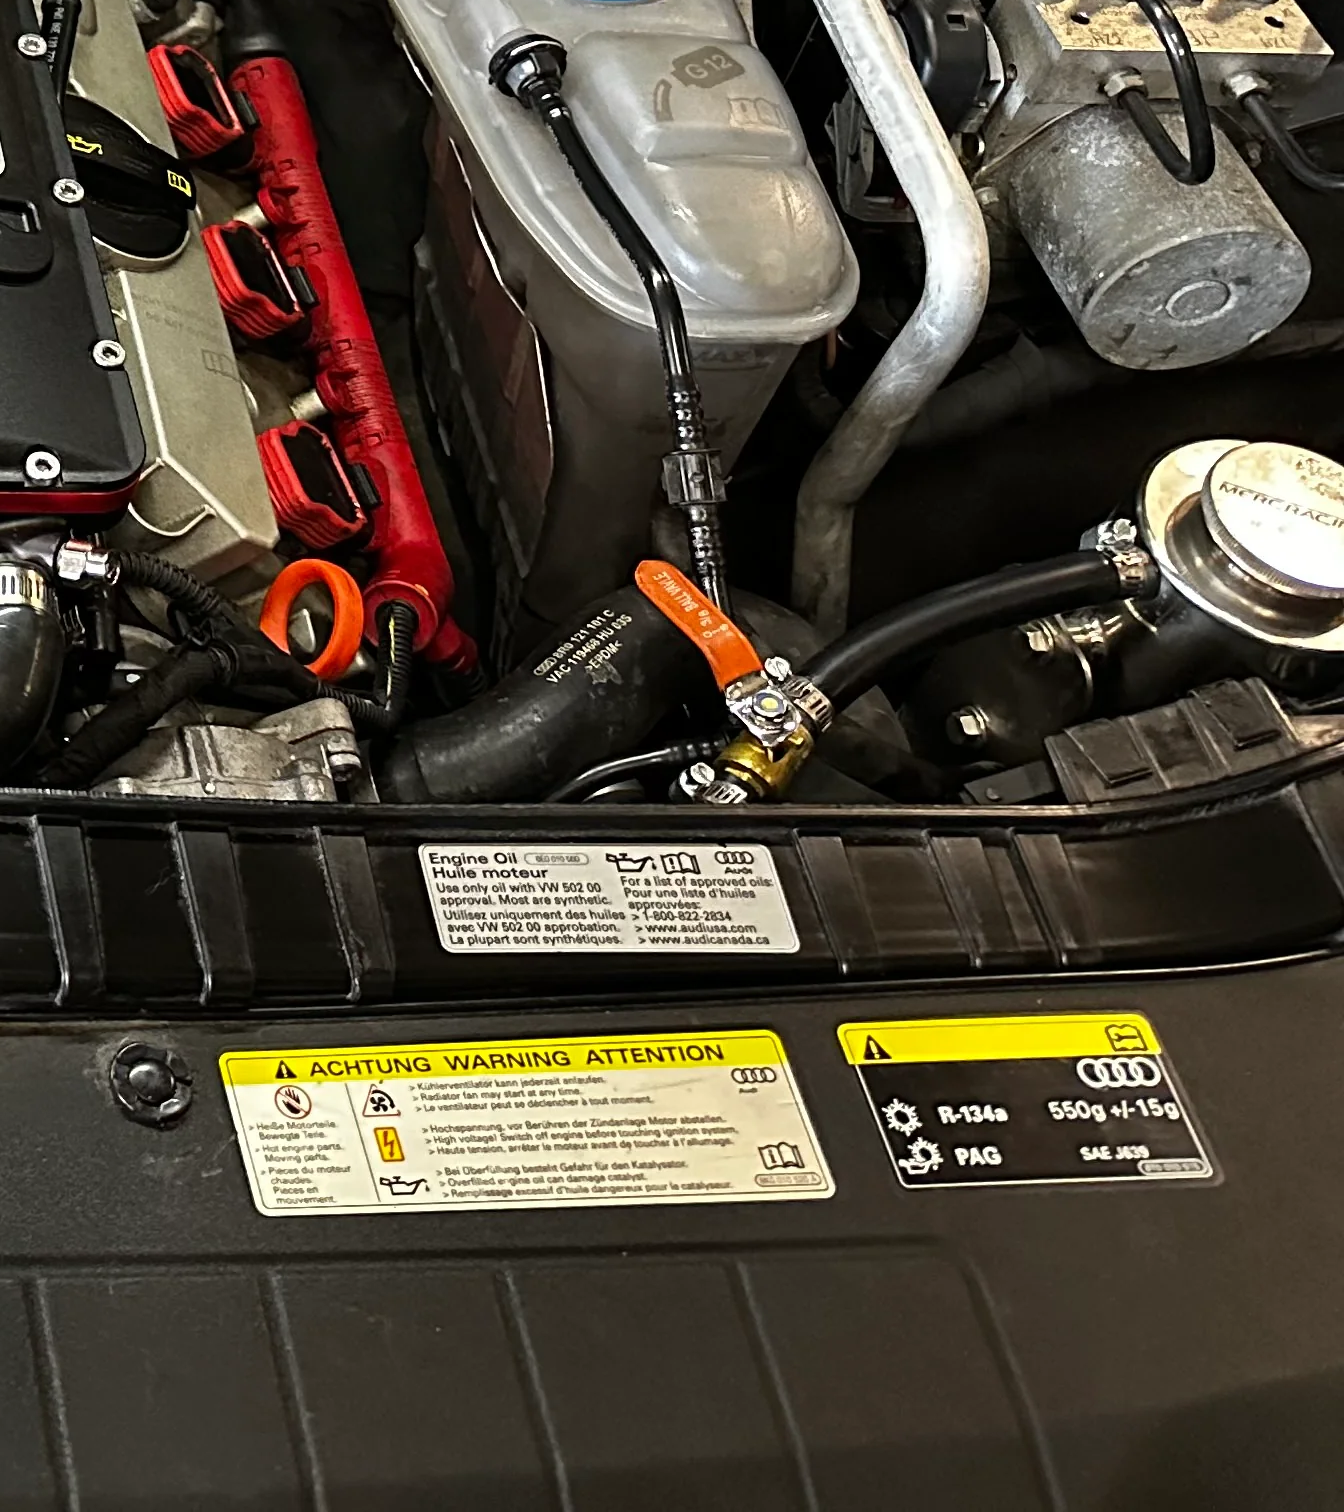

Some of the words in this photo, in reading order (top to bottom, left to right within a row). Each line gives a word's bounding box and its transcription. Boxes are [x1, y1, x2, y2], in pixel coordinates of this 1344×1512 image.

[674, 592, 699, 612] BALL
[570, 629, 590, 643] 121
[586, 616, 606, 629] 101
[603, 609, 614, 618] C
[546, 664, 571, 683] VAC
[596, 627, 614, 641] HU
[428, 852, 489, 867] Engine
[494, 852, 518, 864] Oil
[433, 867, 477, 879] Huile
[483, 868, 549, 879] moteur
[620, 876, 640, 886] For
[644, 878, 652, 886] a
[654, 876, 672, 886] list
[674, 876, 687, 886] of
[690, 876, 746, 888] approved
[749, 877, 774, 887] oils:
[436, 883, 460, 893] Use
[463, 883, 489, 895] only
[492, 882, 507, 893] oil
[509, 882, 536, 893] with
[537, 882, 559, 893] VW
[562, 882, 583, 892] 502
[586, 882, 602, 892] 00
[623, 888, 652, 898] Pour
[655, 890, 678, 898] une
[680, 888, 706, 898] liste
[708, 888, 756, 898] d'huiles
[440, 895, 497, 907] approval.
[499, 895, 530, 905] Most
[532, 896, 552, 905] are
[555, 895, 611, 907] synthetic.
[443, 909, 487, 920] Utilisez
[490, 909, 563, 923] uniquement
[565, 909, 587, 920] des
[589, 909, 627, 920] huiles
[643, 910, 732, 921] 1-800-822-2834
[447, 923, 475, 932] avec
[477, 922, 499, 932] VW
[501, 922, 524, 932] 502
[526, 922, 541, 932] 00
[544, 922, 621, 934] approbation.
[646, 922, 757, 933] www.audiusa.com
[449, 934, 464, 945] La
[467, 934, 510, 946] plupart
[513, 935, 540, 945] sont
[542, 934, 623, 947] synthétiques.
[649, 934, 770, 945] www.audicanada.ca
[310, 1056, 431, 1077] ACHTUNG
[444, 1050, 570, 1071] WARNING
[586, 1044, 724, 1066] ATTENTION
[494, 1078, 518, 1087] kann
[420, 1091, 460, 1101] Radiator
[481, 1091, 501, 1100] may
[504, 1090, 525, 1098] start
[424, 1104, 435, 1112] Le
[438, 1102, 488, 1111] ventilateur
[491, 1101, 512, 1111] peut
[589, 1097, 609, 1105] tout
[937, 1104, 1009, 1124] R-134a
[1048, 1099, 1107, 1123] 550g
[572, 1119, 588, 1128] der
[648, 1116, 677, 1125] Motor
[433, 1134, 456, 1145] High
[500, 1132, 532, 1142] Switch
[535, 1131, 549, 1139] off
[551, 1131, 584, 1141] engine
[585, 1129, 617, 1138] before
[618, 1128, 661, 1138] touching
[282, 1144, 314, 1153] engine
[437, 1146, 465, 1155] Haute
[554, 1142, 588, 1150] moteur
[591, 1141, 618, 1149] avant
[633, 1139, 670, 1148] toucher
[1079, 1145, 1112, 1161] SAE
[264, 1154, 301, 1163] Moving
[954, 1146, 1003, 1166] PAG
[301, 1166, 314, 1174] du
[316, 1165, 351, 1173] moteur
[448, 1177, 495, 1186] Overfilled
[498, 1177, 530, 1186] engine
[533, 1176, 544, 1184] oil
[566, 1174, 605, 1184] damage
